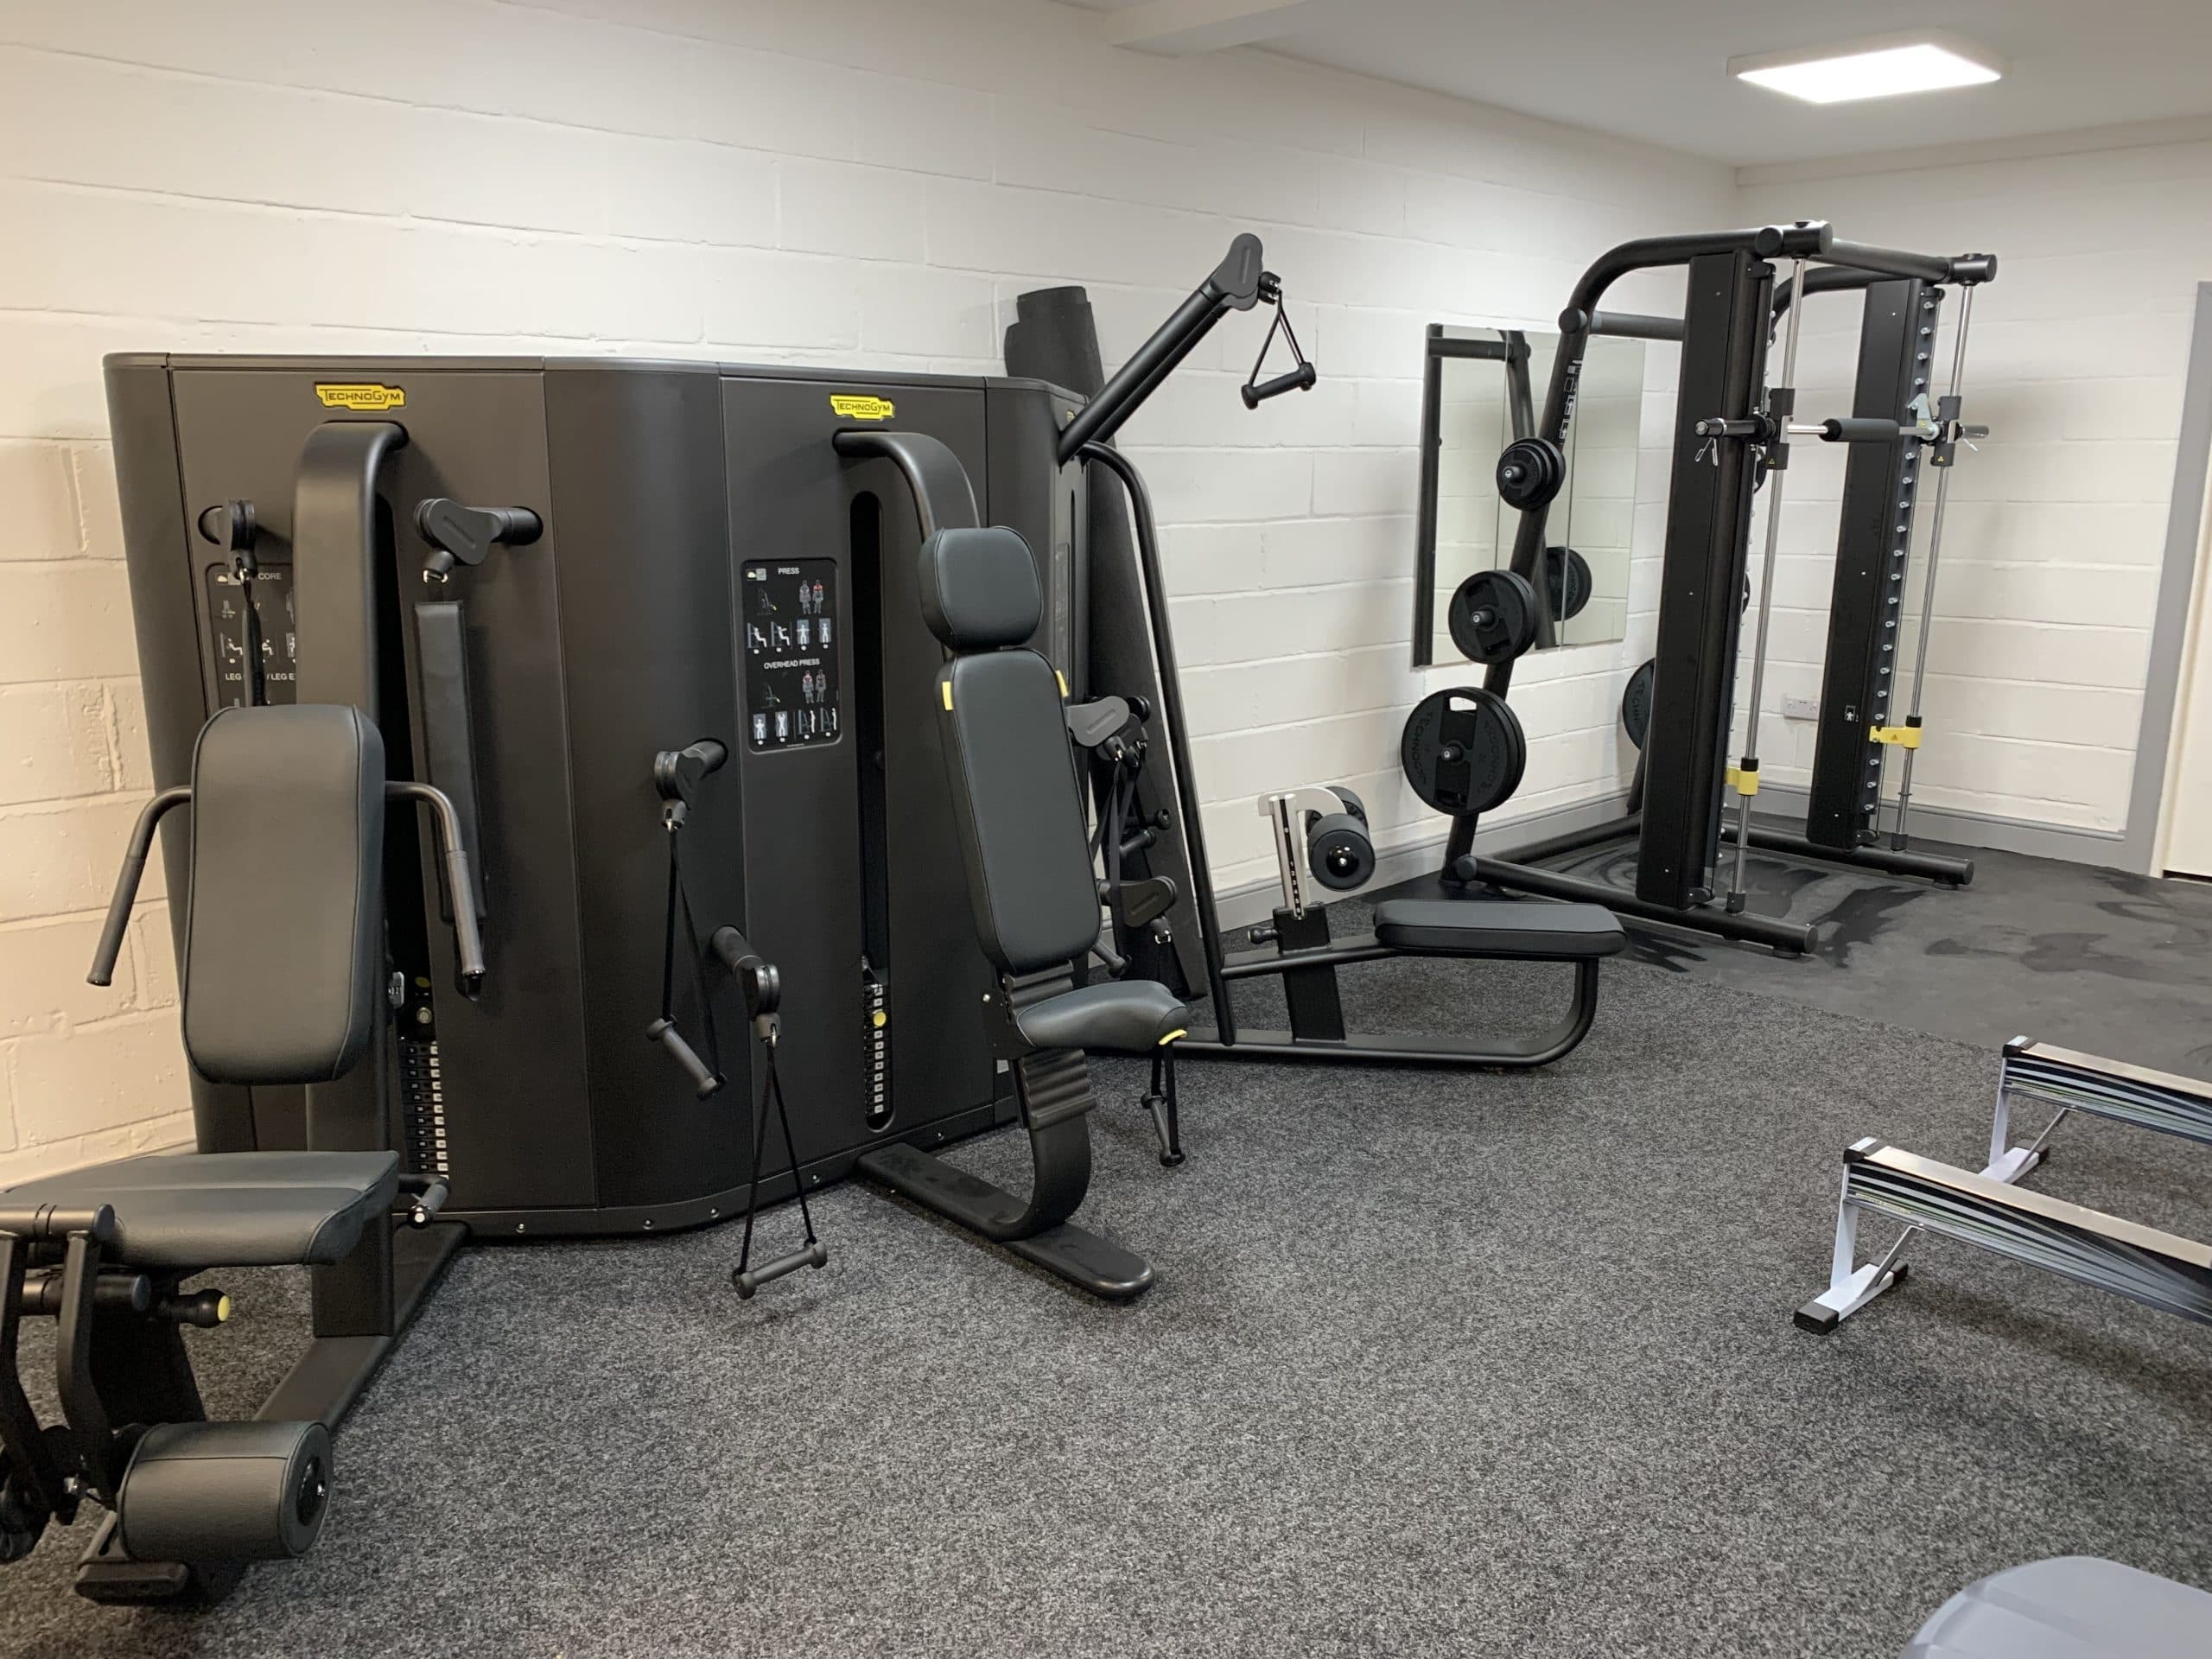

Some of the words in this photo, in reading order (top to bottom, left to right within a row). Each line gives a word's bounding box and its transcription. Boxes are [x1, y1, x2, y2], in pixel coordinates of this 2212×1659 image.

[257, 572, 283, 581] CORE
[763, 659, 798, 670] OVERHEAD
[799, 658, 820, 666] PRESS
[225, 672, 242, 681] LEG
[270, 672, 288, 681] LEG
